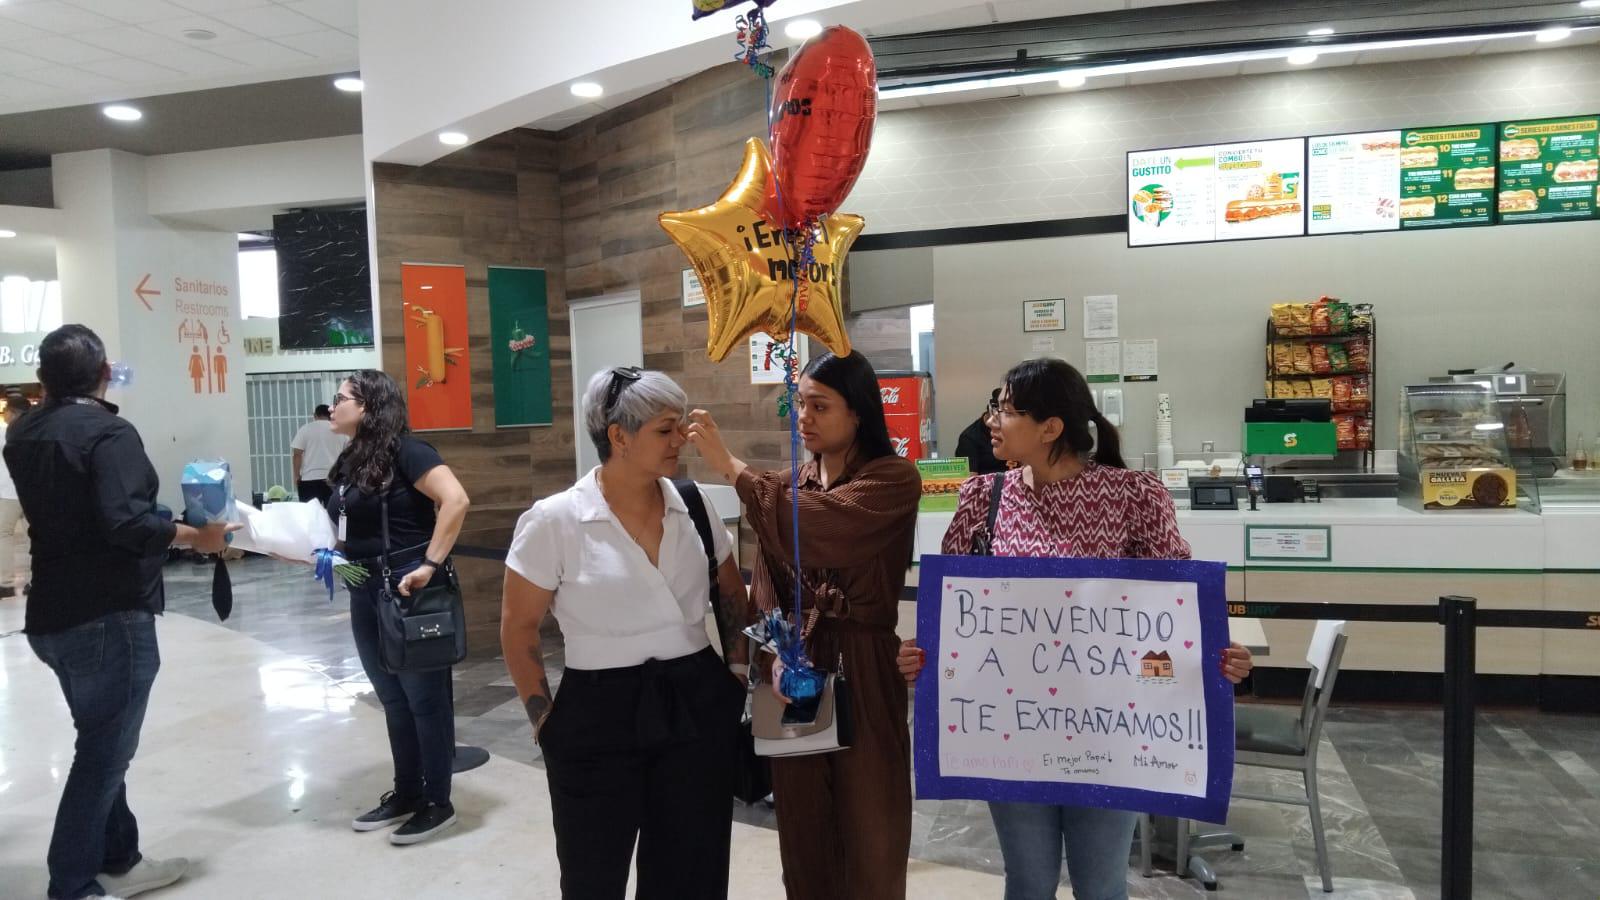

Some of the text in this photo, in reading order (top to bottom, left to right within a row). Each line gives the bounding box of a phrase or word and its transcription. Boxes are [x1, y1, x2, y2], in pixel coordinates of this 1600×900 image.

[1440, 144, 1450, 152] 10
[1132, 165, 1172, 177] GUSTITO
[174, 277, 229, 297] Sanitarios
[175, 299, 230, 318] Restrooms
[954, 588, 1174, 642] BIENVENIDO
[978, 642, 1132, 677] A CASA
[950, 697, 1204, 750] TE EXTRAÑAMOS!!
[1133, 753, 1179, 770] Mi Amor
